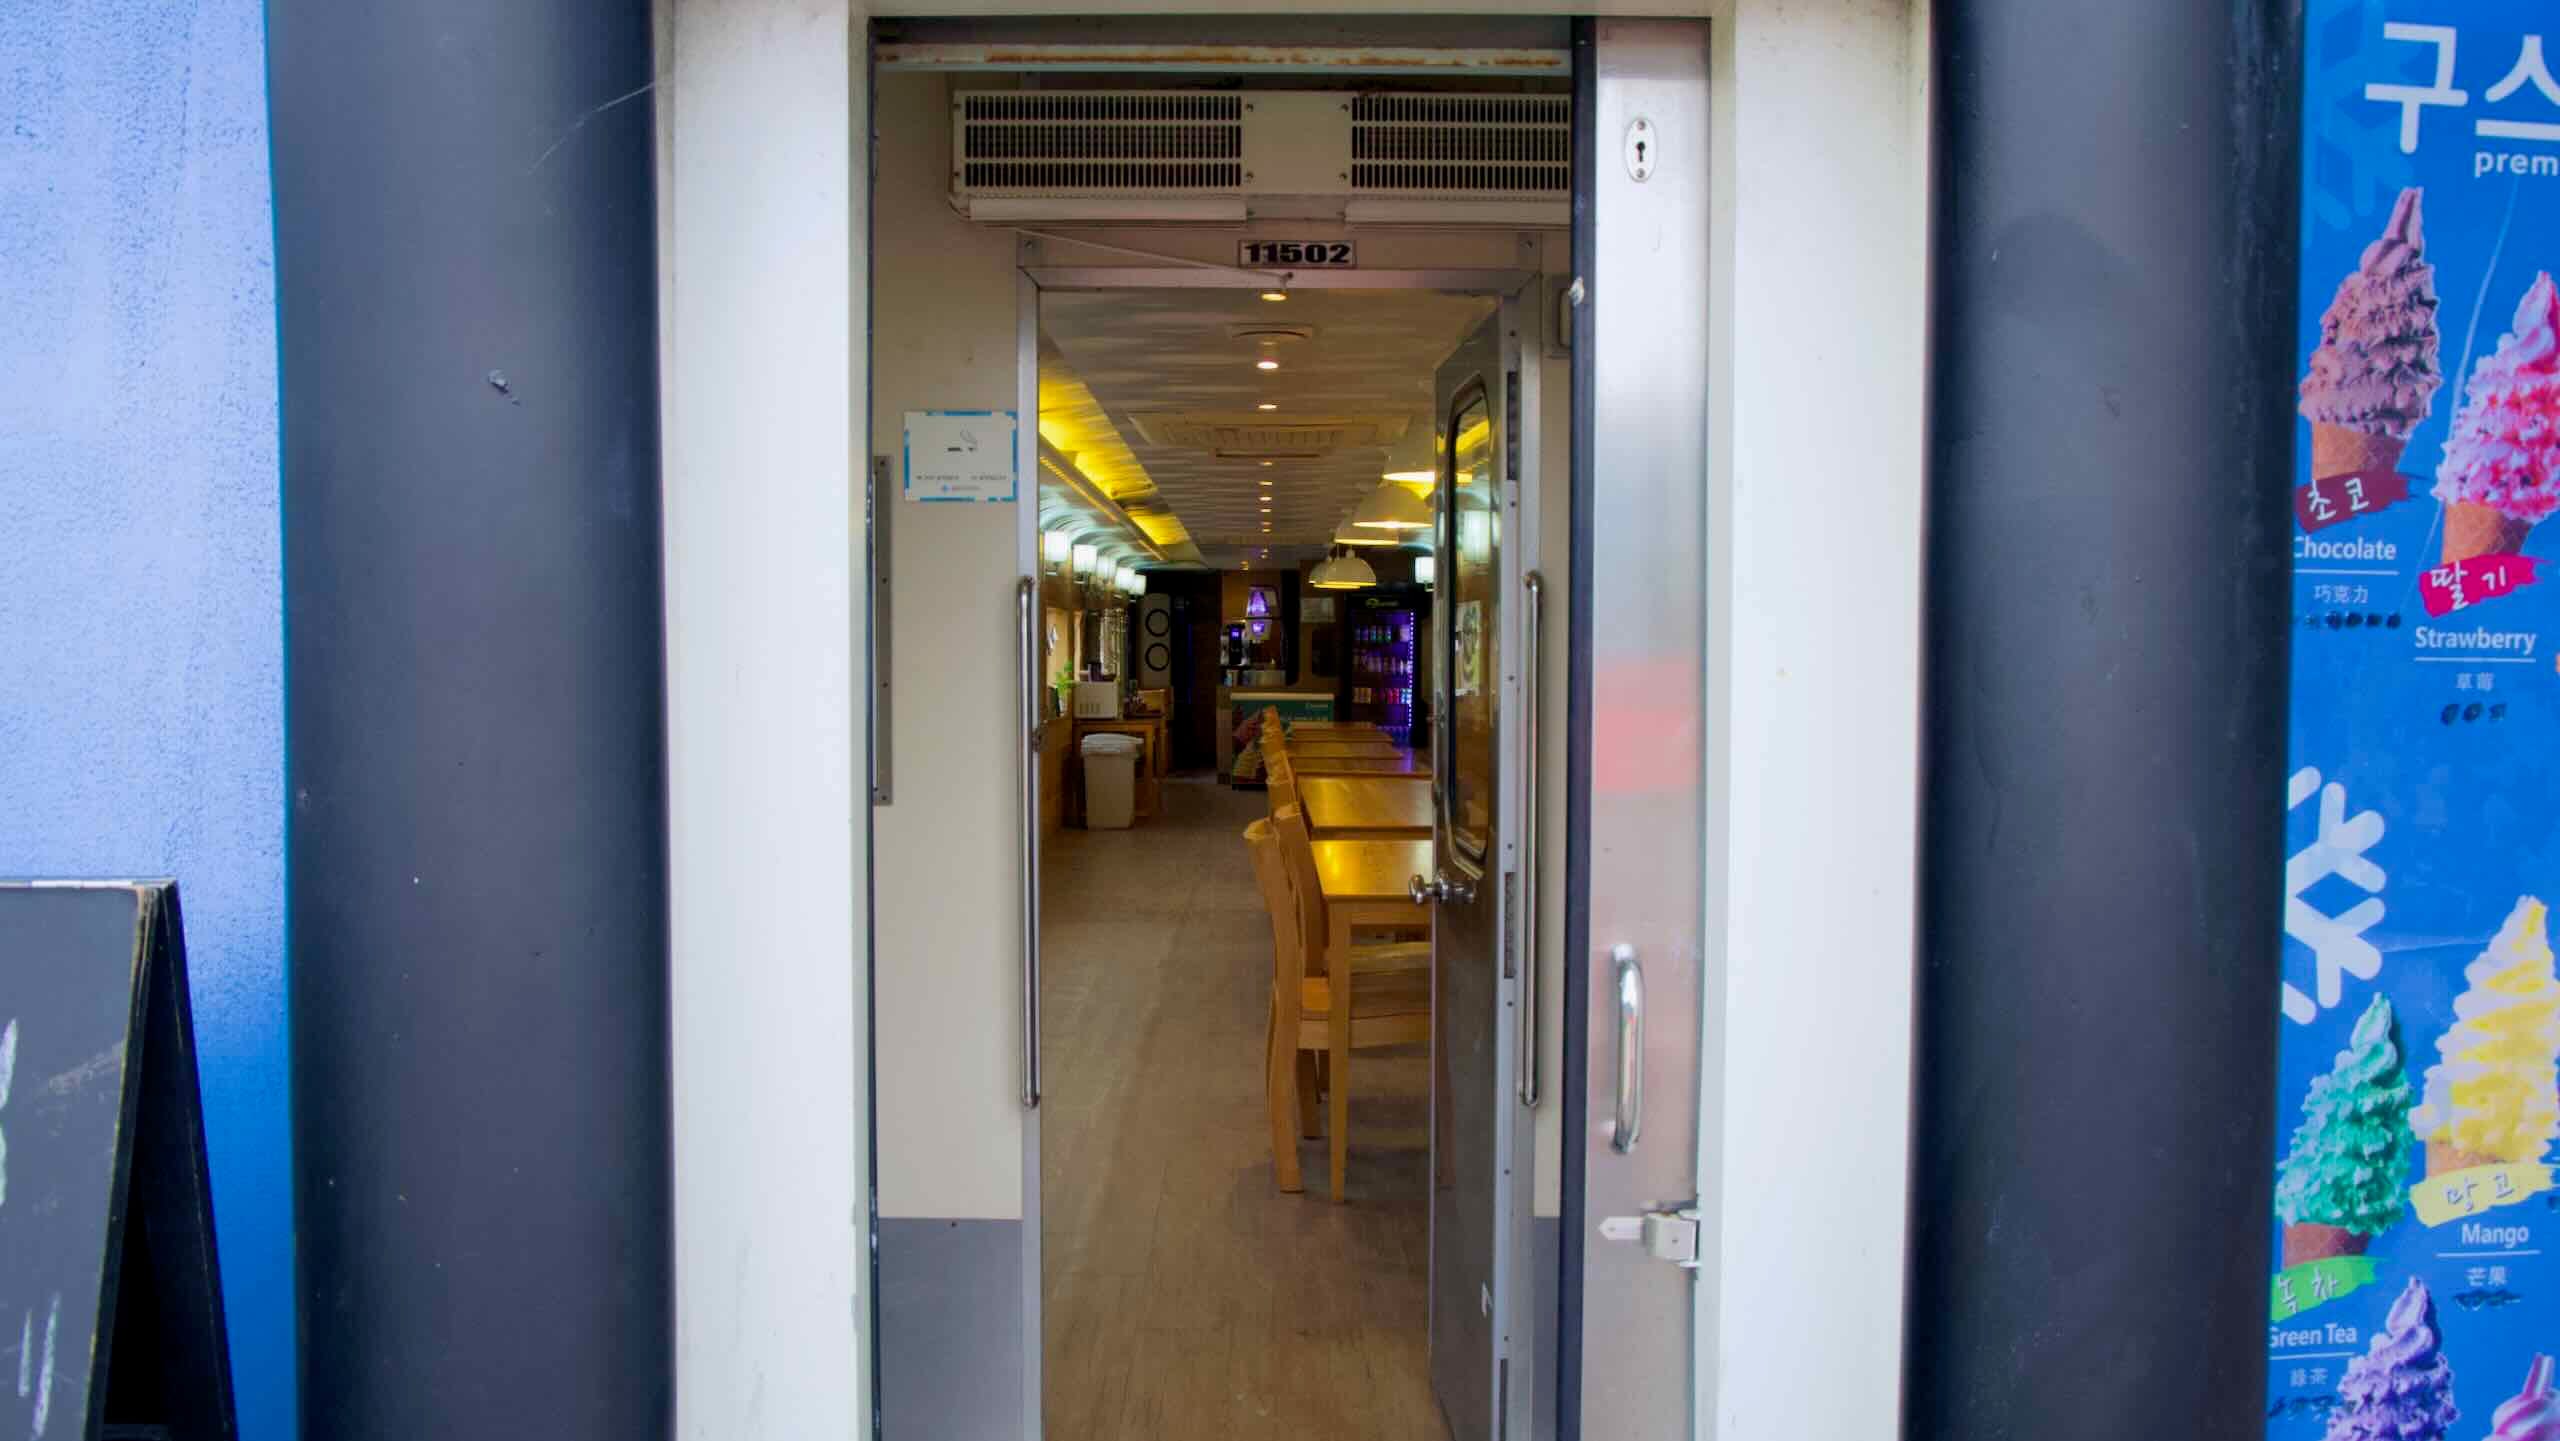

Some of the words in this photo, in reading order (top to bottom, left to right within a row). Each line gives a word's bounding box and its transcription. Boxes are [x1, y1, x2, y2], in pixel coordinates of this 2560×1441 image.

[2475, 152, 2559, 178] prem
[1244, 243, 1351, 263] 11502
[2415, 626, 2537, 655] Strawberry
[2461, 1223, 2529, 1248] Mango
[2325, 1322, 2358, 1345] Tea
